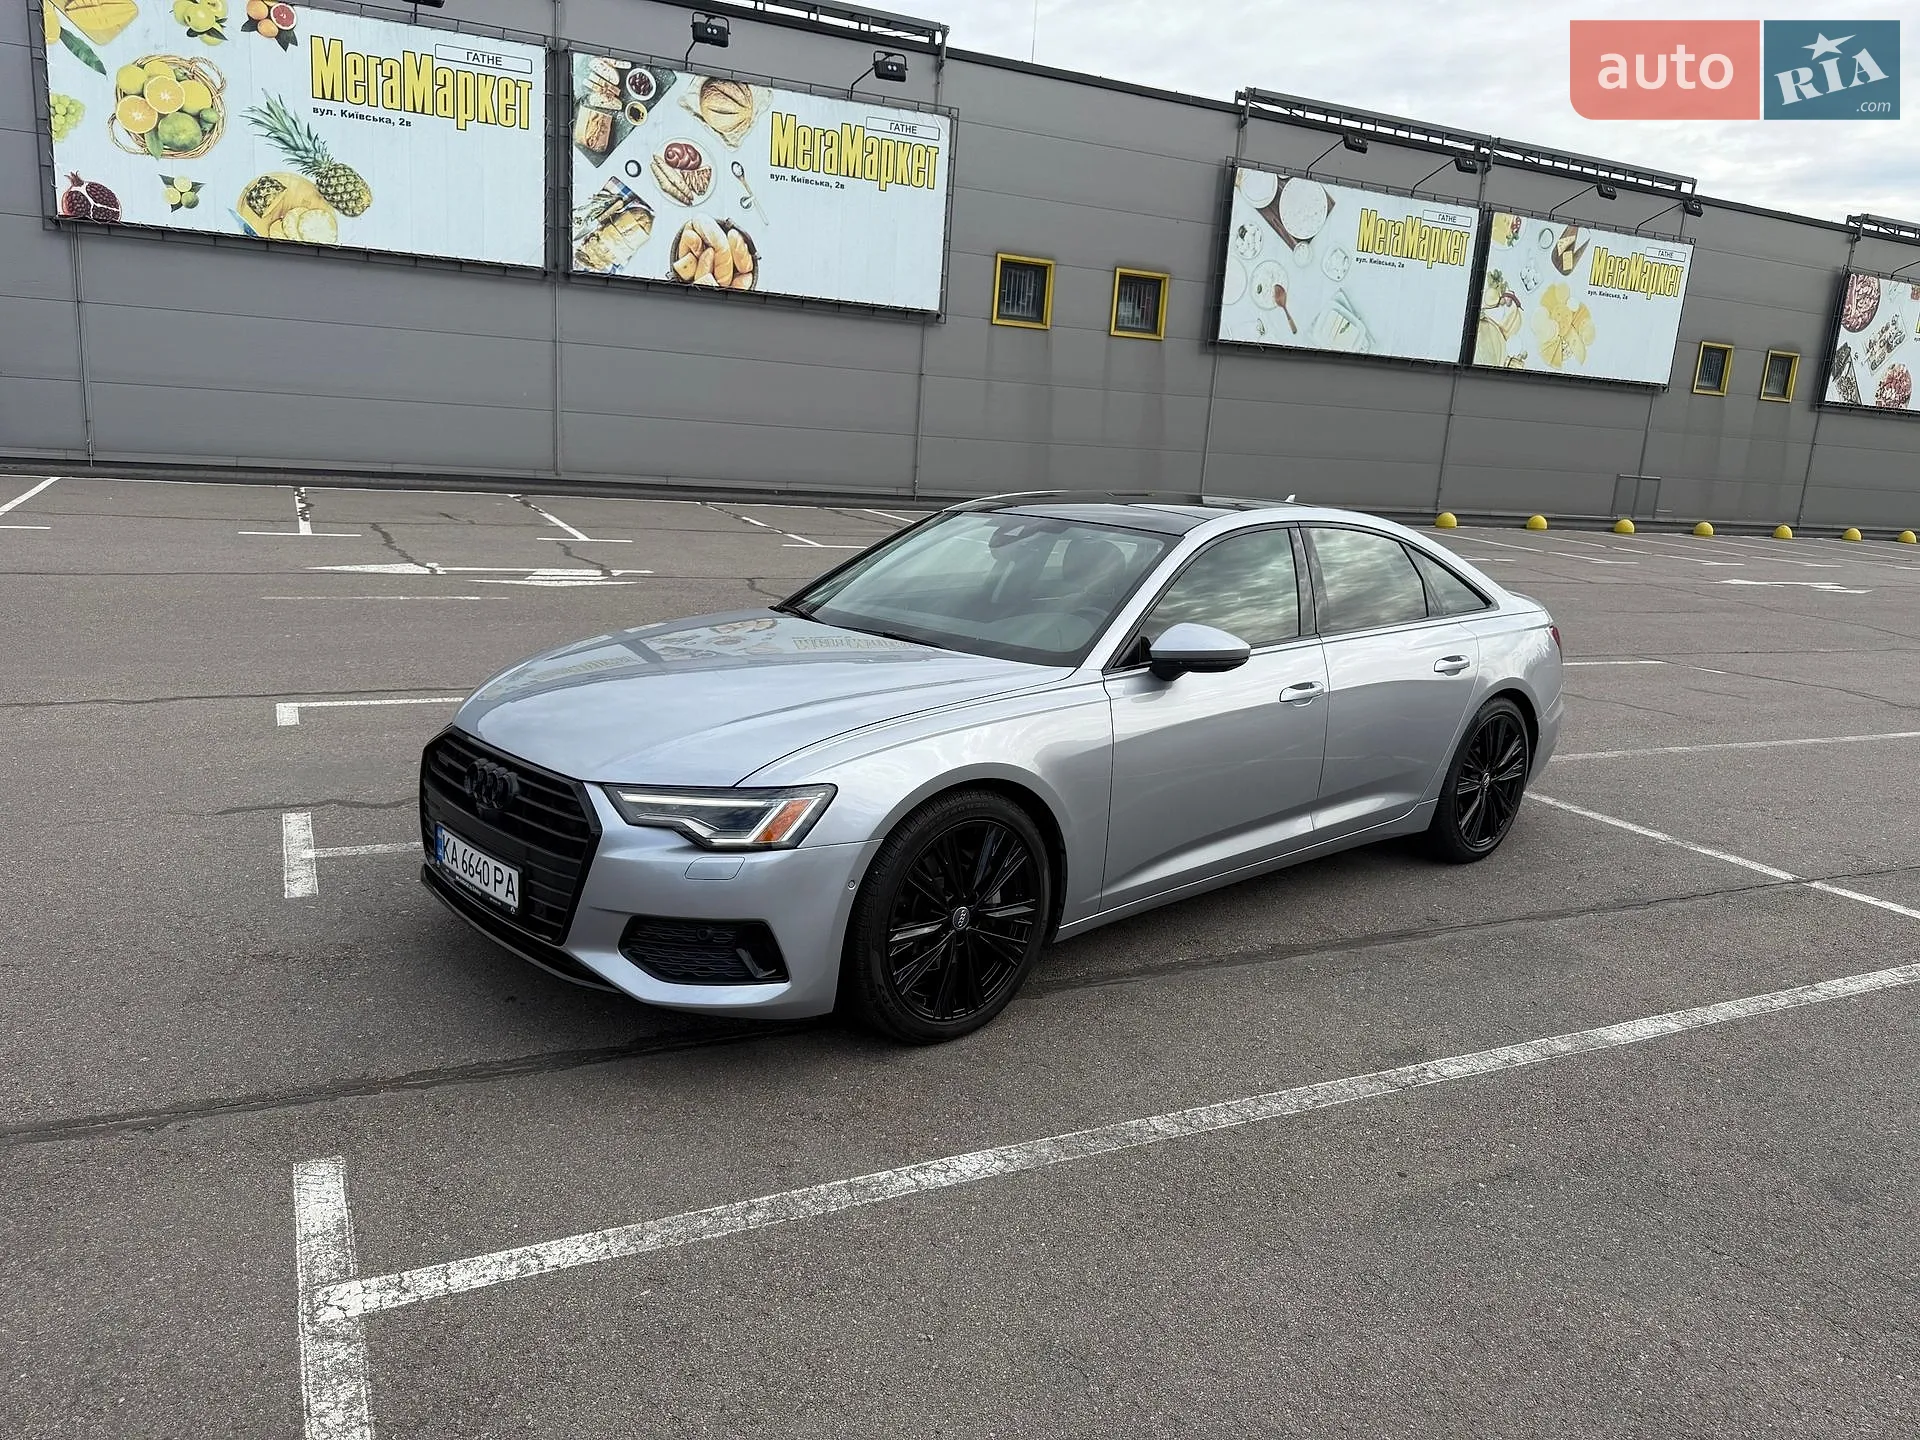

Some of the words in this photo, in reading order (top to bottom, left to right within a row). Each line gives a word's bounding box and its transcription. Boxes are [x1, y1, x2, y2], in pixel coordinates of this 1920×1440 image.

[310, 35, 532, 131] МегаМаркет
[466, 51, 502, 66] ГАТНЕ
[312, 107, 337, 117] вул.
[340, 110, 395, 126] Київська,
[398, 118, 412, 127] 2в
[889, 122, 917, 134] ГАТНЕ
[770, 111, 939, 192] МегаМаркет
[770, 173, 789, 182] вул.
[791, 175, 833, 188] Київська,
[1357, 208, 1470, 269] МегаМаркет
[1589, 246, 1684, 300] МегаМаркет
[442, 834, 459, 869] KA
[461, 849, 490, 887] 6640
[494, 866, 516, 901] PA
